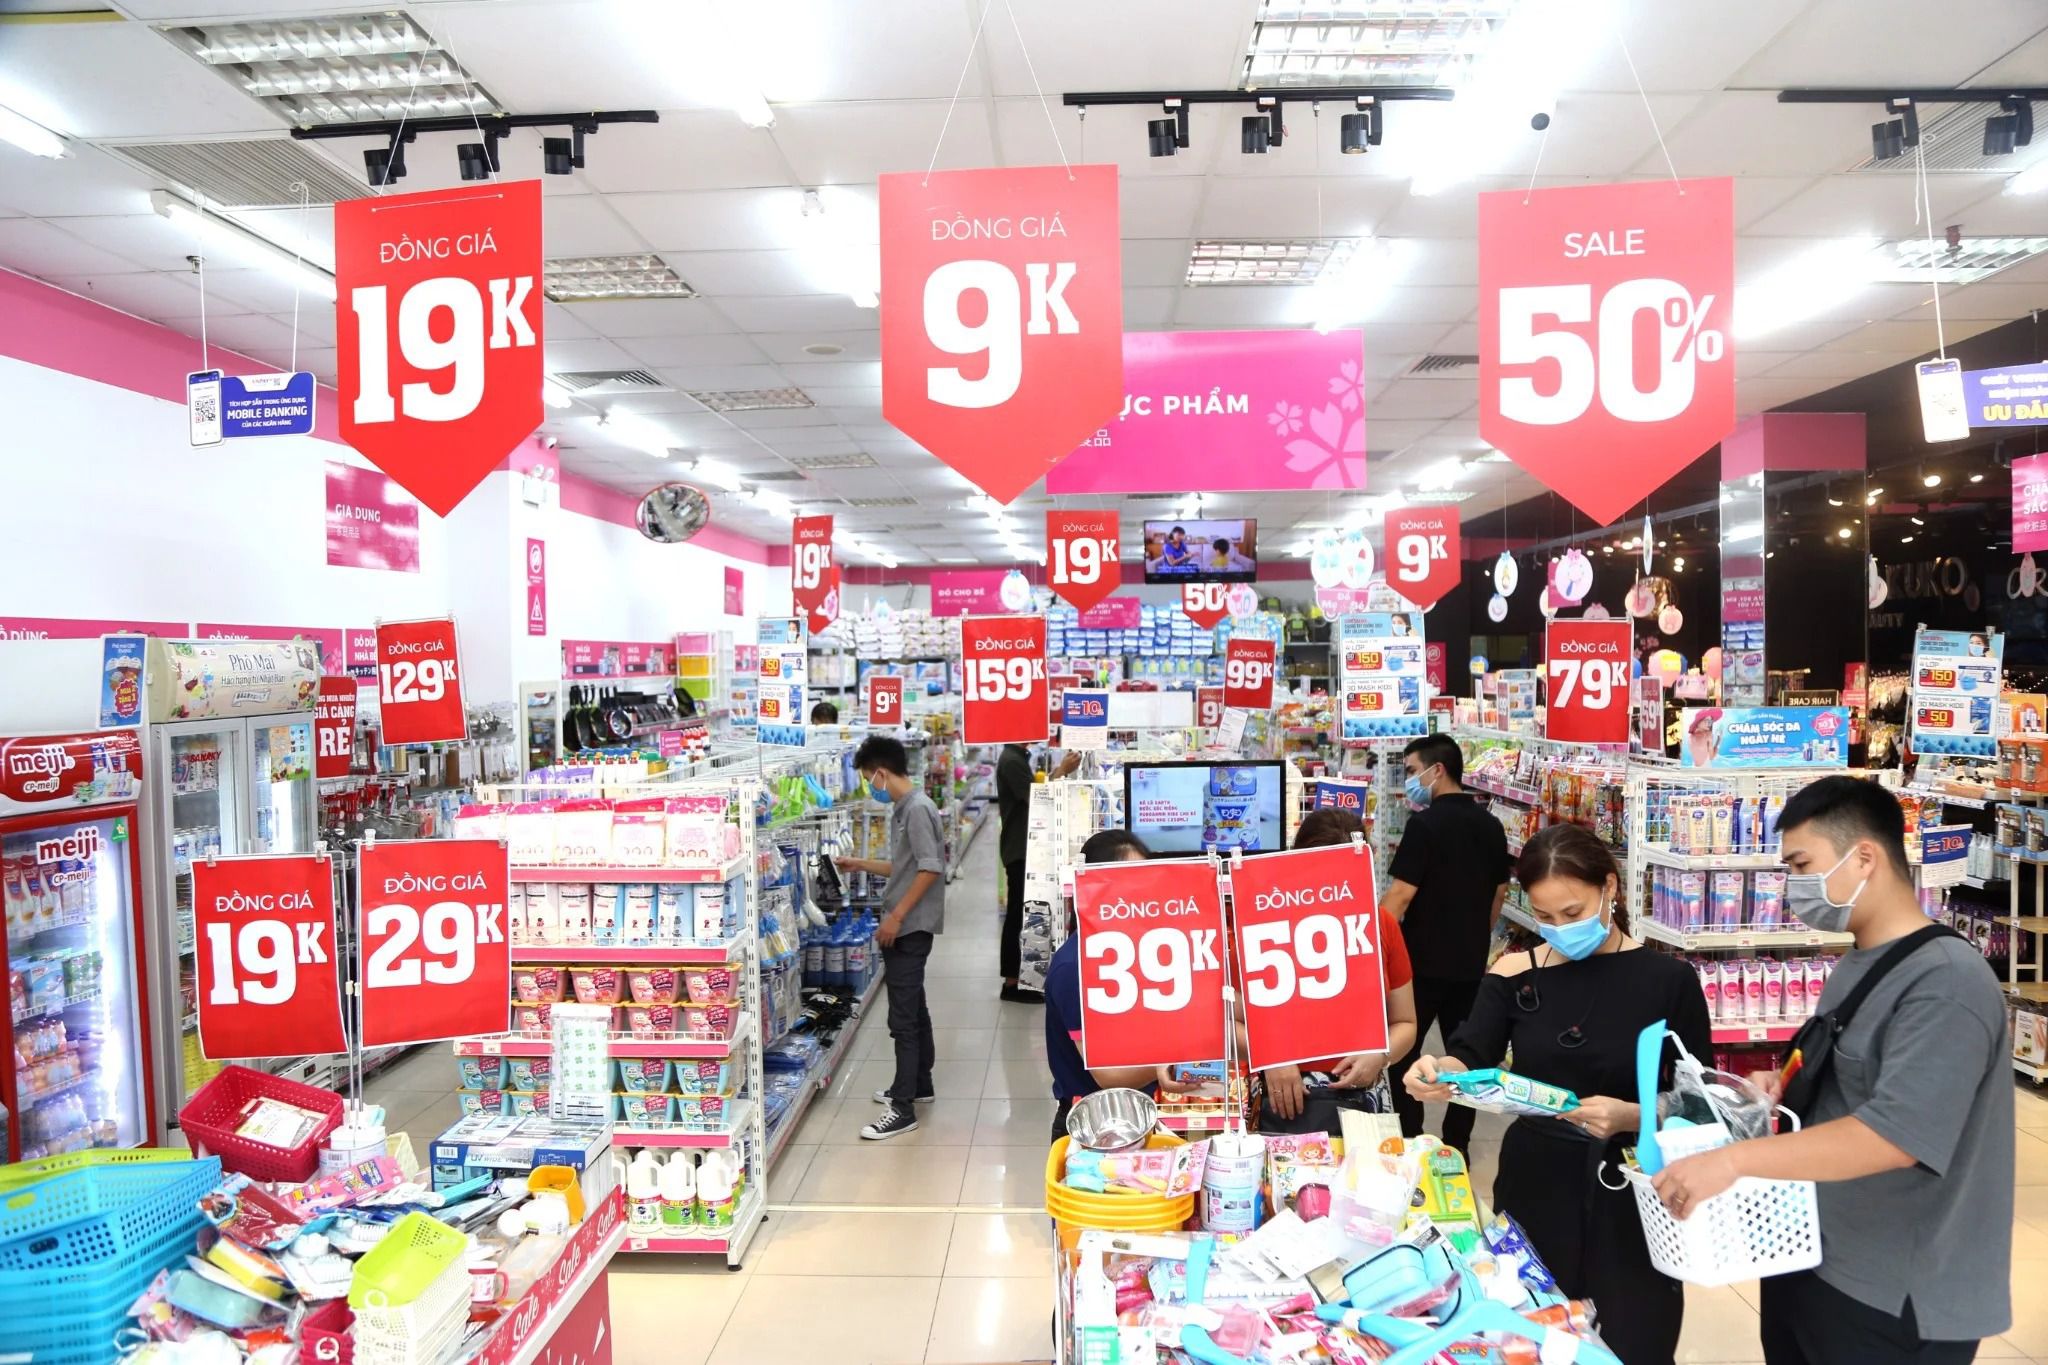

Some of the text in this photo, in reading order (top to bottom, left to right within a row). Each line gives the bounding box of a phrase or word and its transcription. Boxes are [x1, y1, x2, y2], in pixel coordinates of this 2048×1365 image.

[931, 210, 1067, 241] ĐỒNG GIÁ
[379, 228, 497, 264] ĐỒNG GIÁ
[1564, 229, 1645, 258] SALE
[923, 259, 1081, 409] 9K
[352, 276, 535, 425] 19K
[1499, 278, 1724, 426] 50%
[227, 406, 308, 420] MOBILE BANKING
[1163, 387, 1249, 416] PHẨM
[1983, 404, 2012, 421] ƯU
[335, 504, 381, 523] GIA DỤNG
[1400, 519, 1444, 530] ĐỒNG GIÁ
[1063, 522, 1104, 532] ĐỒNG GIÁ
[793, 543, 831, 589] 19K
[1053, 537, 1118, 585] 19K
[1397, 535, 1448, 583] 9K
[953, 589, 972, 597] CHO
[11, 628, 48, 641] DÙNG
[388, 639, 444, 655] ĐỒNG GIÁ
[975, 636, 1036, 651] ĐỒNG GIÁ
[1234, 649, 1268, 659] ĐỒNG GIÁ
[1359, 652, 1378, 663] 150
[1560, 641, 1618, 654] ĐỒNG GIÁ
[254, 654, 276, 671] Mai
[1227, 660, 1273, 689] 99K
[380, 659, 457, 704] 129K
[964, 657, 1046, 702] 159K
[1550, 659, 1628, 710] 79K
[1931, 670, 1952, 681] 150
[314, 703, 355, 719] GIÁ CÀNG
[766, 701, 777, 711] 50
[875, 691, 898, 713] 9K
[1360, 694, 1377, 705] 50
[1763, 721, 1784, 733] SÓC
[1785, 722, 1800, 732] DA
[1931, 711, 1948, 722] 50
[319, 719, 351, 757] RẺ
[1740, 733, 1786, 745] NGÀY HÈ
[11, 746, 66, 776] meiji
[24, 779, 59, 792] CP-meiji
[38, 828, 98, 861] meiji
[53, 870, 91, 884] CP-meiji
[384, 870, 487, 894] ĐỒNG GIÁ
[215, 889, 314, 913] ĐỒNG GIÁ
[1099, 896, 1200, 921] ĐỒNG GIÁ
[1255, 881, 1354, 911] ĐỒNG GIÁ
[366, 901, 505, 989] 29K
[206, 919, 328, 1005] 19K
[1085, 927, 1220, 1015] 39K
[1242, 913, 1374, 1008] 59K
[596, 1200, 617, 1245] Sale
[557, 1245, 581, 1293] Sale
[512, 1293, 539, 1351] Sale
